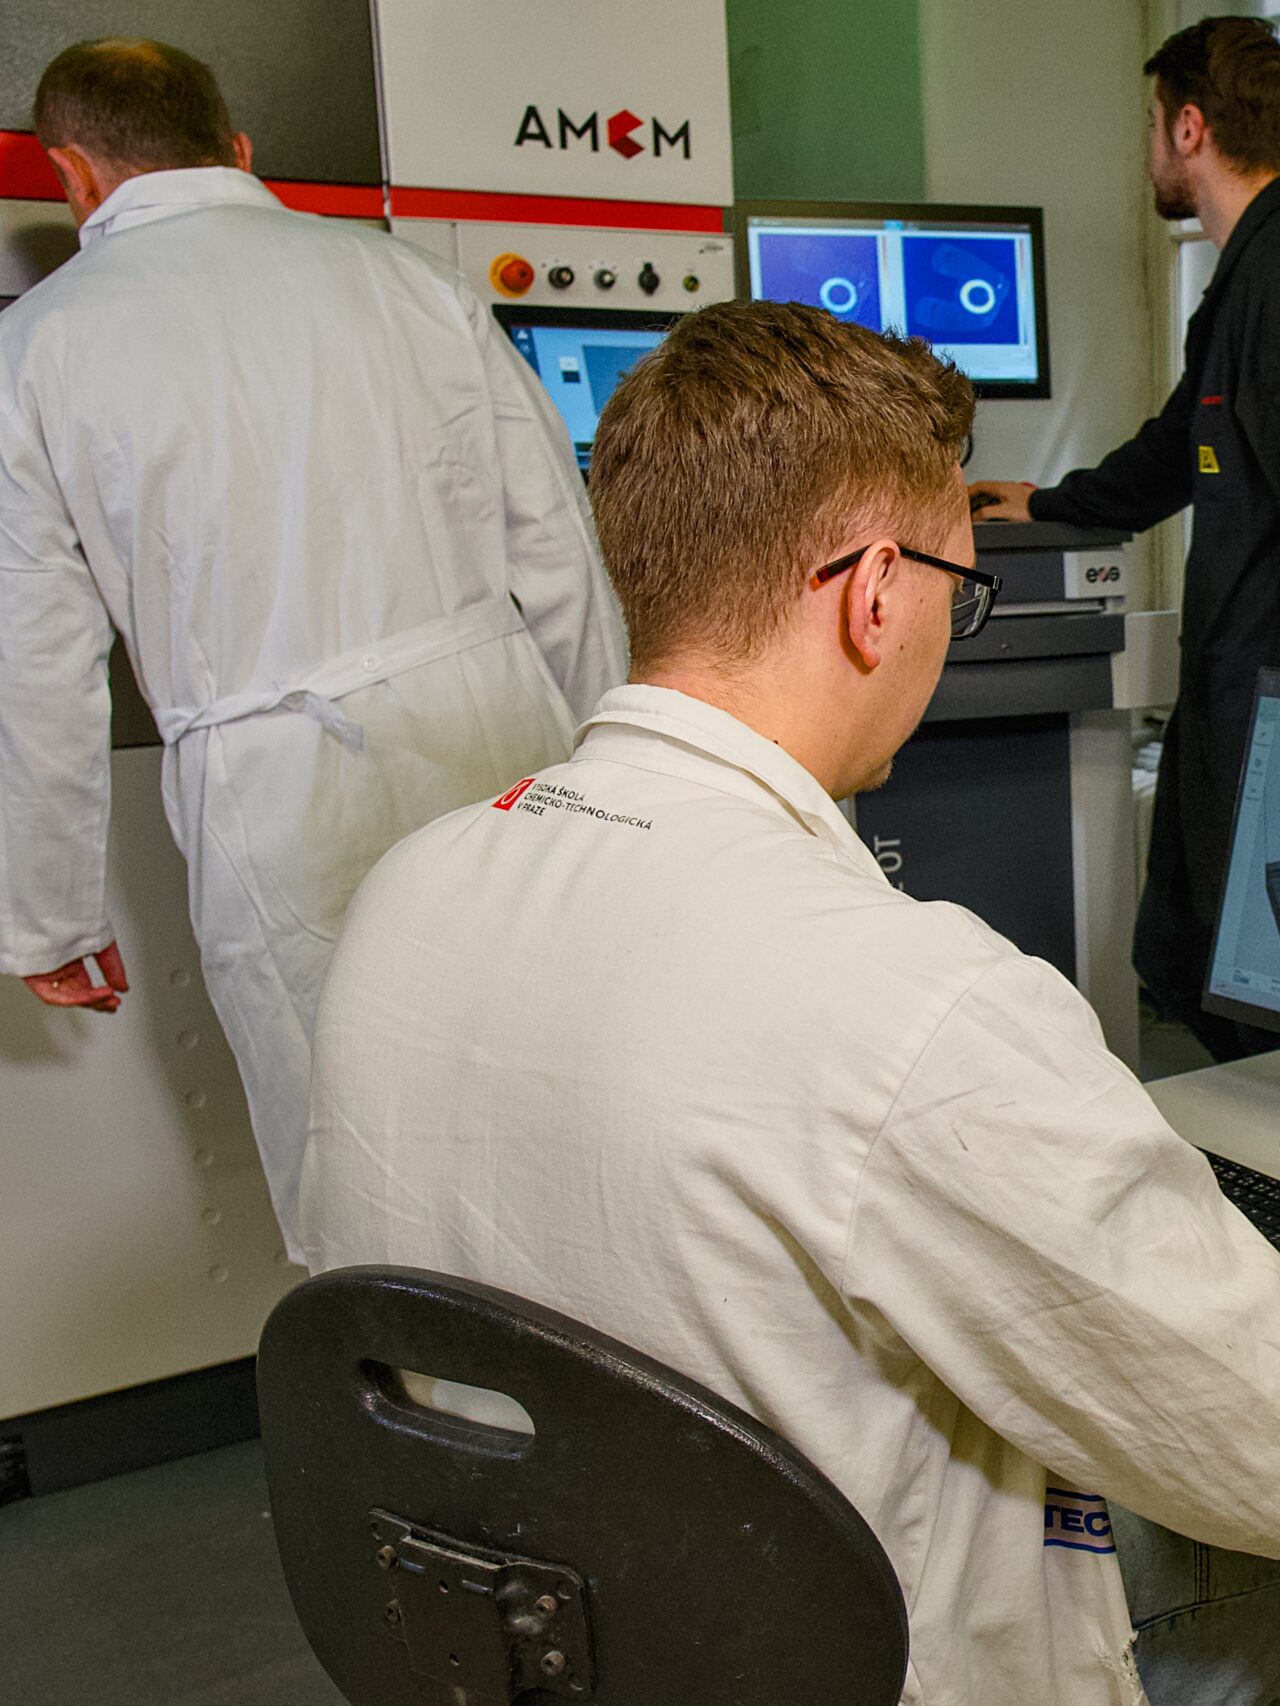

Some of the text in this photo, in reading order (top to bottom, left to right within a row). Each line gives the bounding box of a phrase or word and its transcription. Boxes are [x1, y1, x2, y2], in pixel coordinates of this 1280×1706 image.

[557, 785, 586, 802] ŠKOLA
[523, 804, 546, 817] PRAZE
[523, 792, 653, 831] CHEMICKO-TECHNOLOGICKÁ
[873, 834, 904, 892] OT
